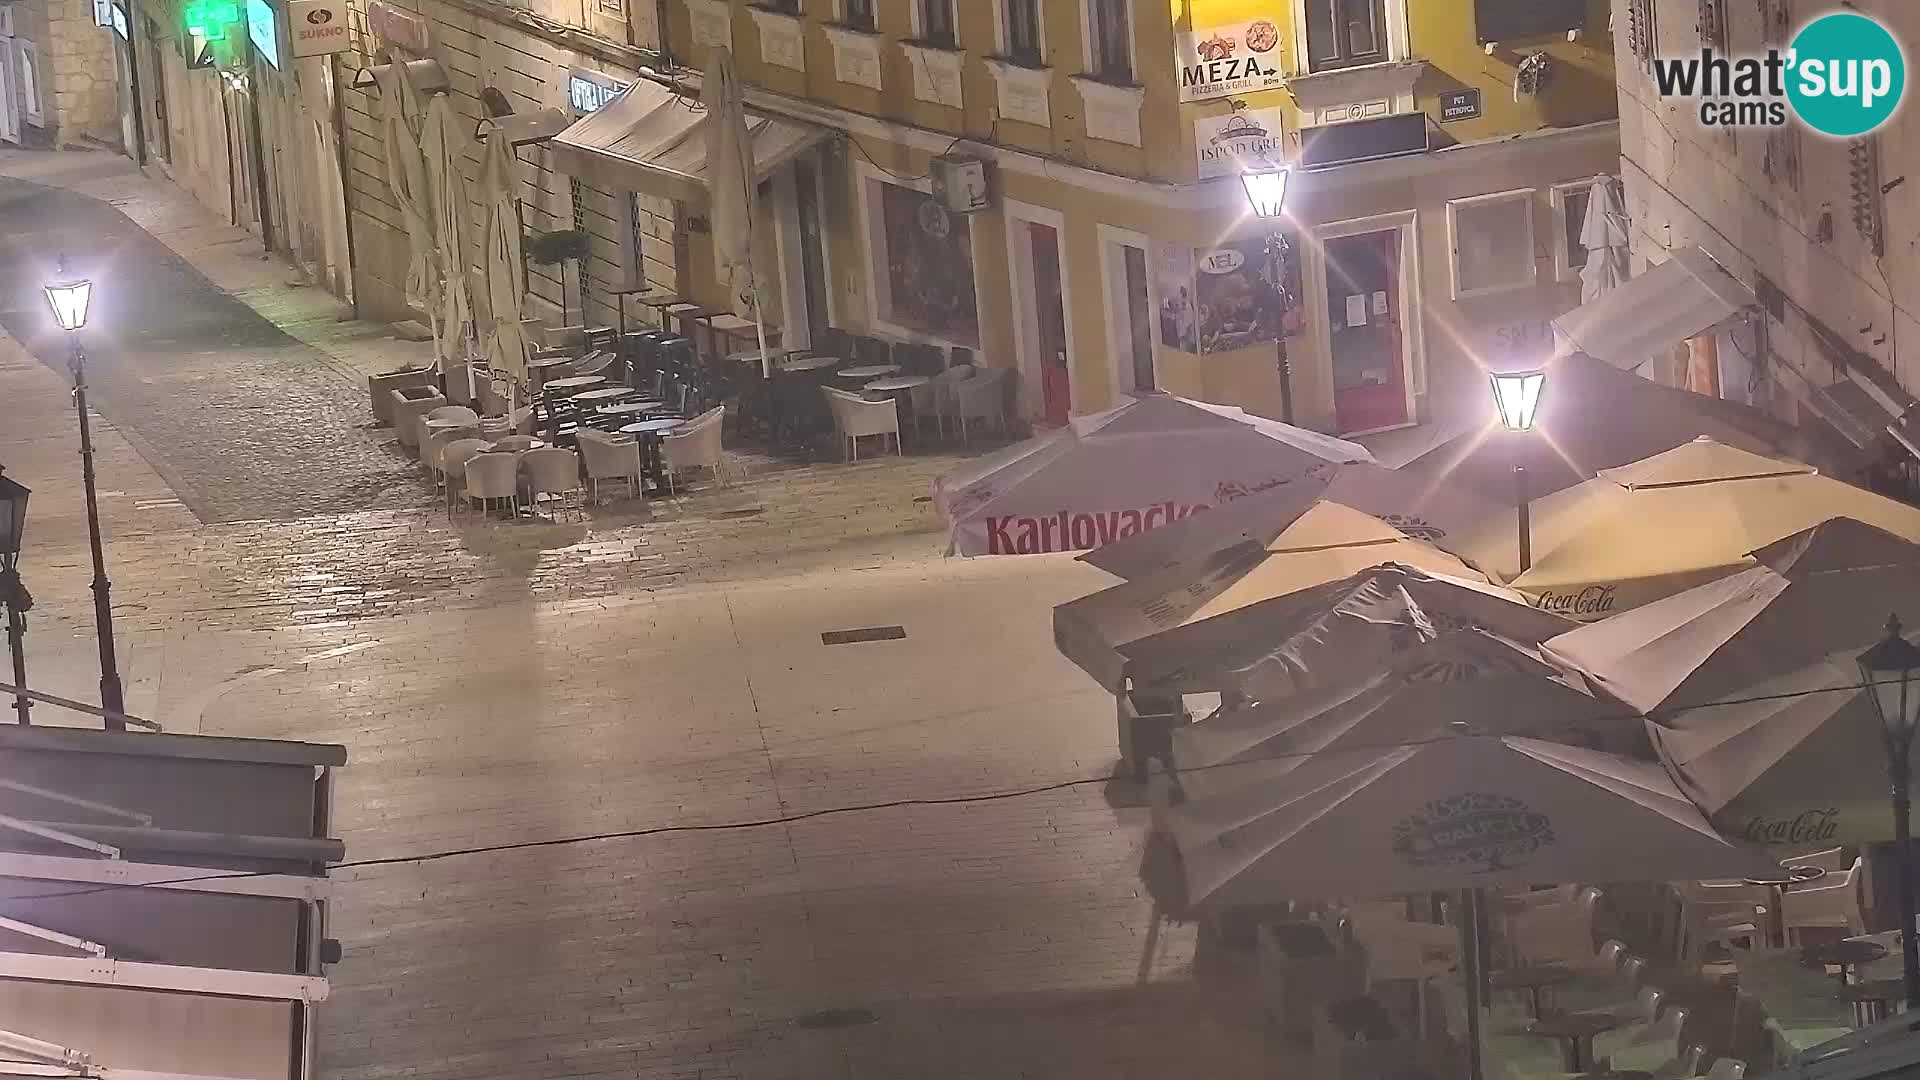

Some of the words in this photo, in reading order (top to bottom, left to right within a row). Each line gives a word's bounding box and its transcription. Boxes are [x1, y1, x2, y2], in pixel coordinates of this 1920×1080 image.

[299, 26, 343, 40] SUKNO
[1182, 57, 1261, 87] MEZA
[1191, 83, 1225, 96] PIZZERIA
[1232, 80, 1253, 90] GRILL
